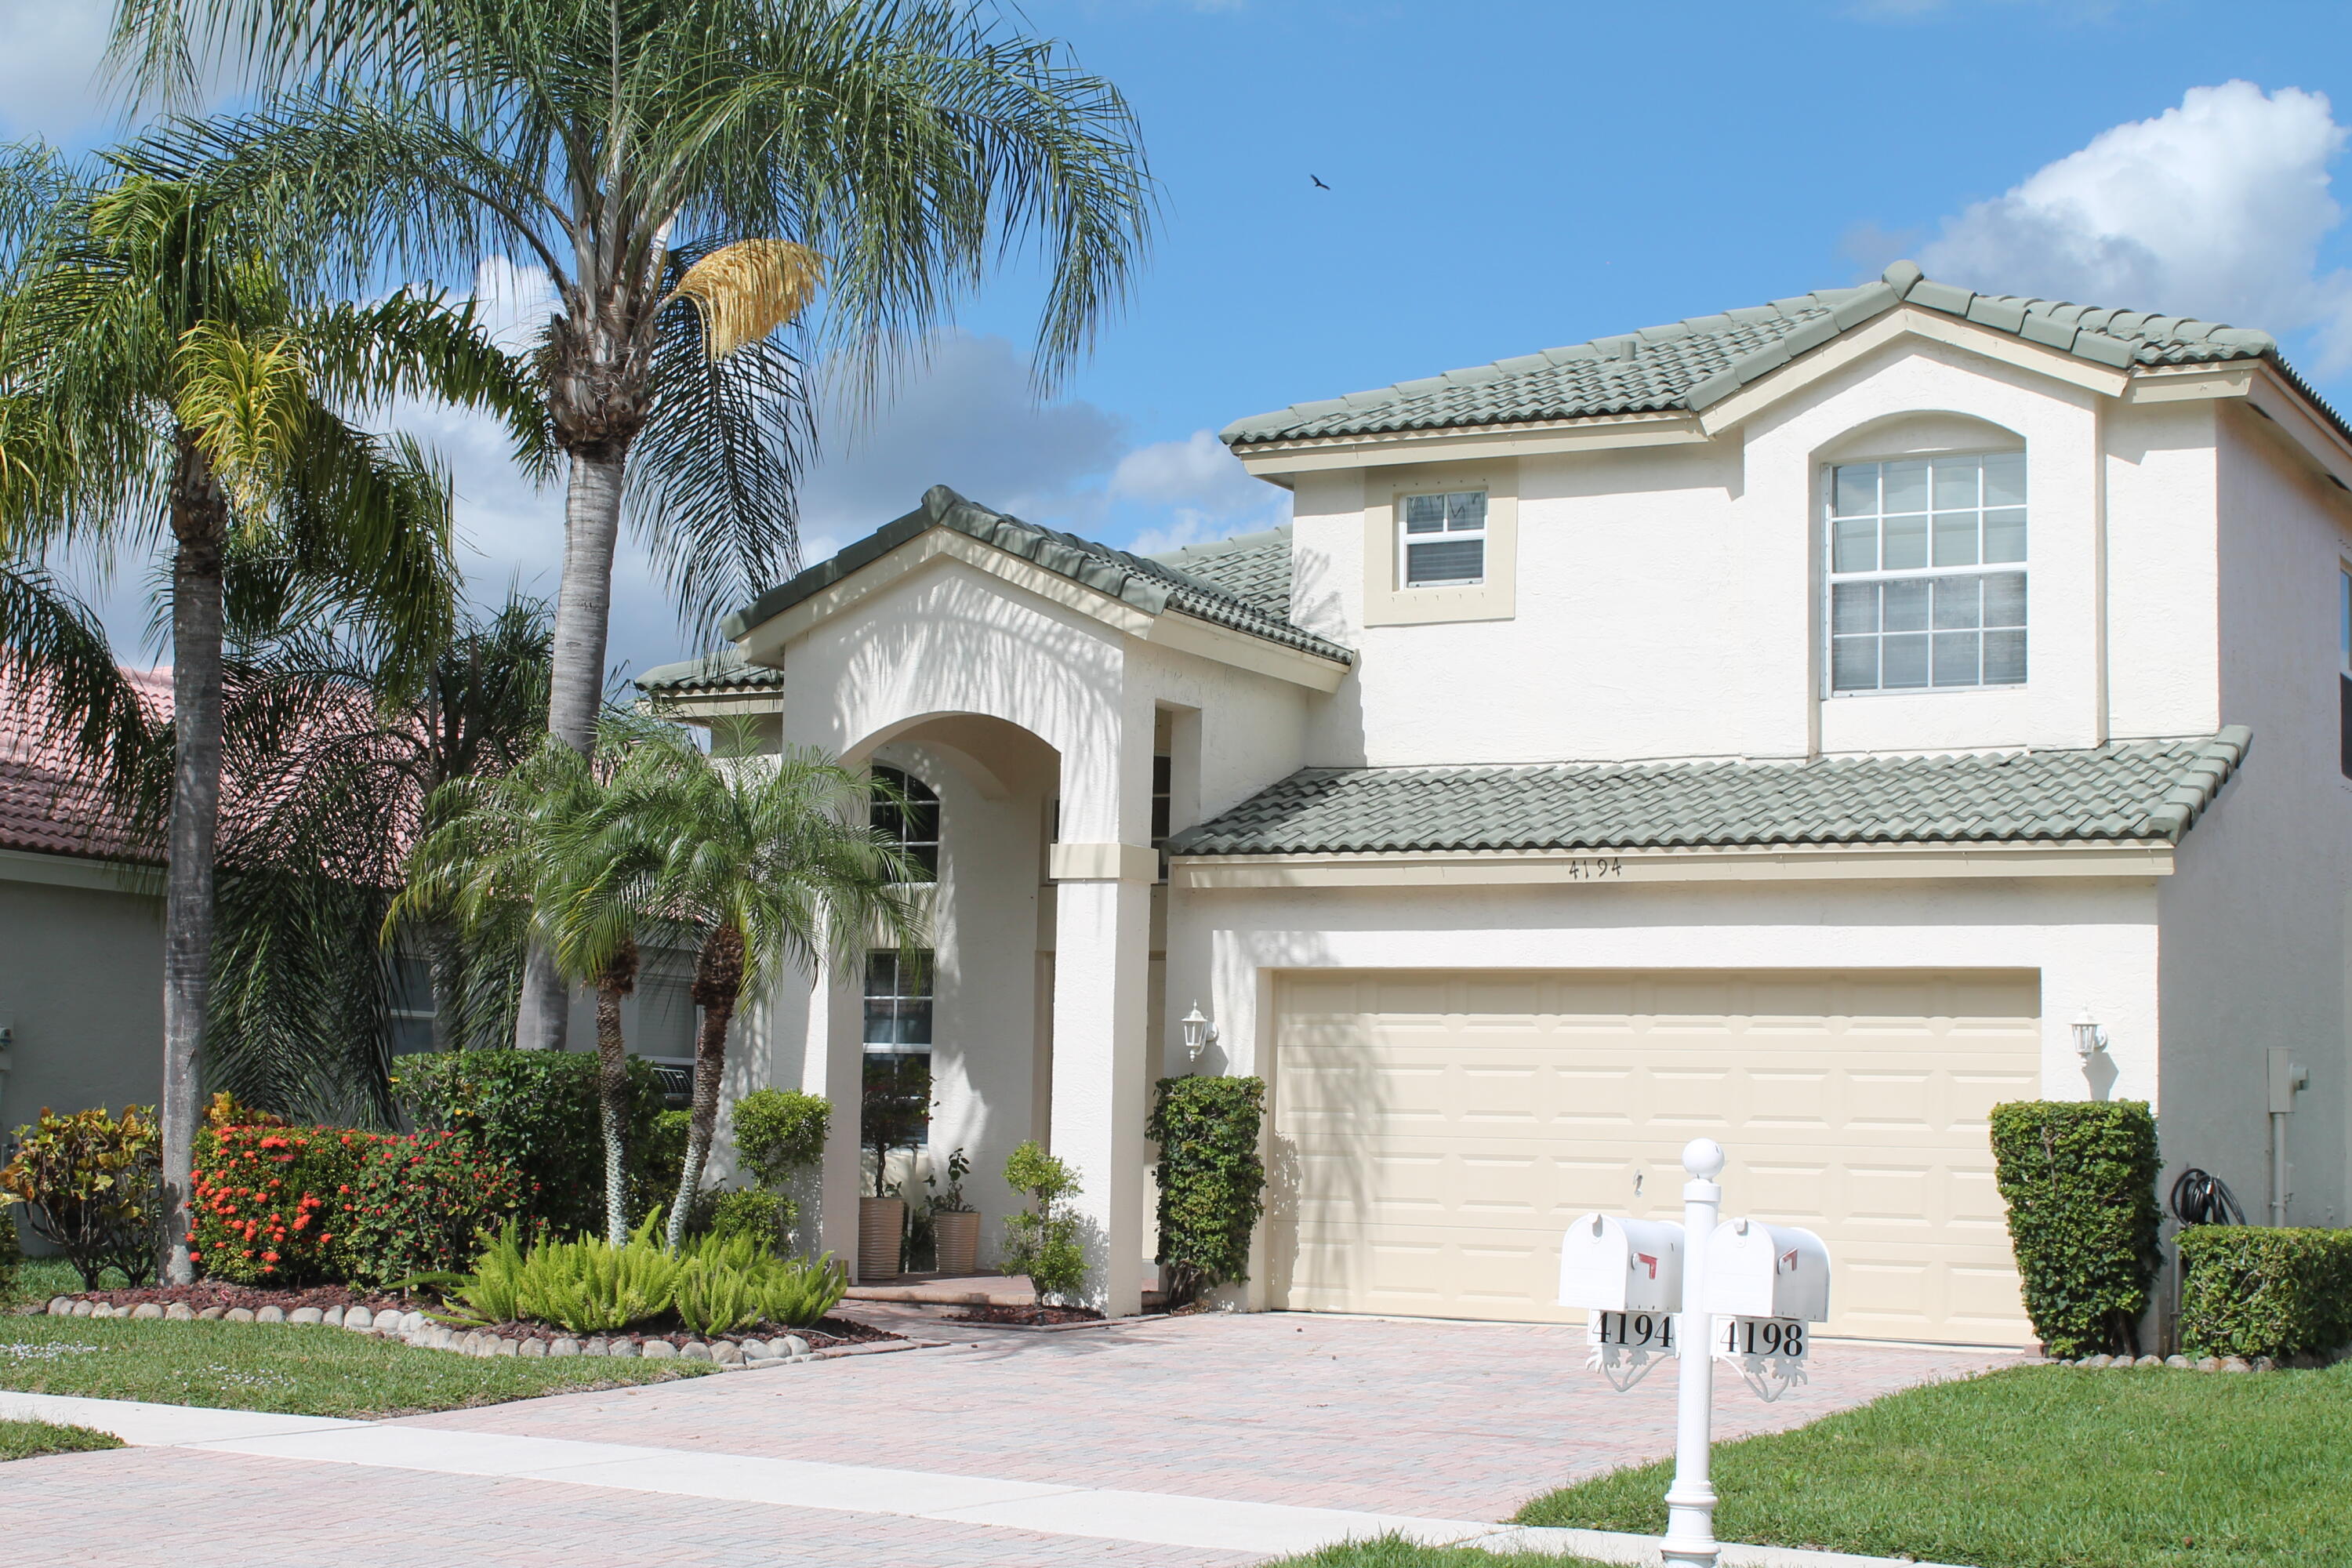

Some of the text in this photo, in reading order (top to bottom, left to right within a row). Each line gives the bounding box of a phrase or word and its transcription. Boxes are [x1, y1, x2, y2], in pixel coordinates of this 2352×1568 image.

[1570, 857, 1621, 879] 4194
[1592, 1312, 1674, 1348] 4194
[1720, 1322, 1803, 1356] 4198
